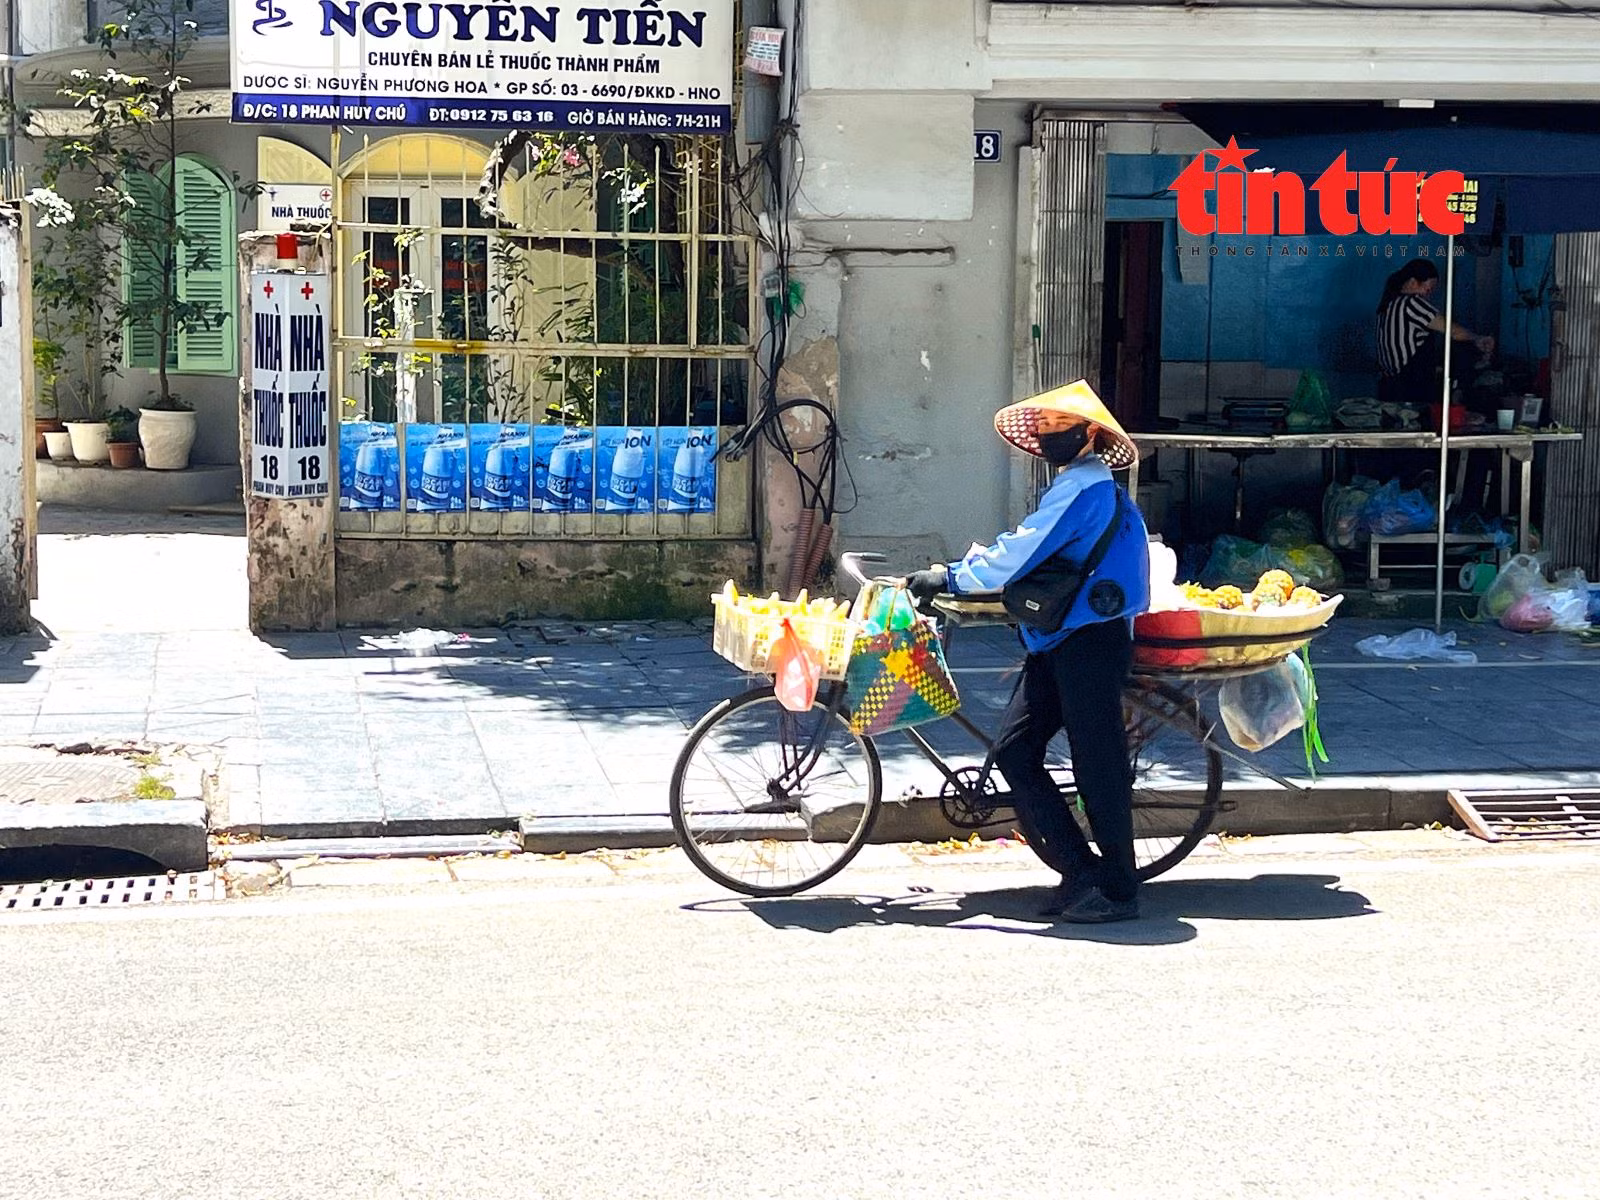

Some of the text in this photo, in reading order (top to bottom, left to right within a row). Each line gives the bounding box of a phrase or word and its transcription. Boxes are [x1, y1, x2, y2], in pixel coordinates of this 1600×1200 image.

[368, 50, 660, 73] CHUYÊN BÁN LẺ THUỐC THÀNH PHẨM
[317, 73, 378, 91] NGUYỄN
[384, 77, 449, 92] PHƯƠNG
[454, 81, 488, 93] HOA
[507, 82, 527, 94] GP
[532, 78, 556, 95] SỐ:
[561, 83, 578, 95] 03
[591, 84, 675, 99] 6690/ĐKKD
[688, 87, 720, 99] HNO
[243, 103, 277, 119] Đ/C:
[282, 104, 298, 118] 18
[302, 105, 340, 119] PHAN
[344, 106, 372, 120] HUY
[375, 104, 406, 120] CHÚ
[491, 110, 508, 121] 75
[512, 110, 532, 122] 63
[536, 111, 554, 122] 16
[567, 108, 594, 125] GIỜ
[597, 108, 624, 125] BÁN
[628, 109, 672, 127] HÀNG:
[675, 114, 721, 128] 7H-21H
[271, 203, 332, 219] NHÀ THUỐC
[255, 303, 282, 372] NHÀ
[290, 303, 325, 372] NHÀ
[254, 373, 284, 449] THUỐC
[289, 372, 327, 449] THUỐC
[625, 434, 652, 449] ION
[686, 433, 713, 448] ION
[260, 454, 279, 480] 18
[297, 454, 321, 481] 18
